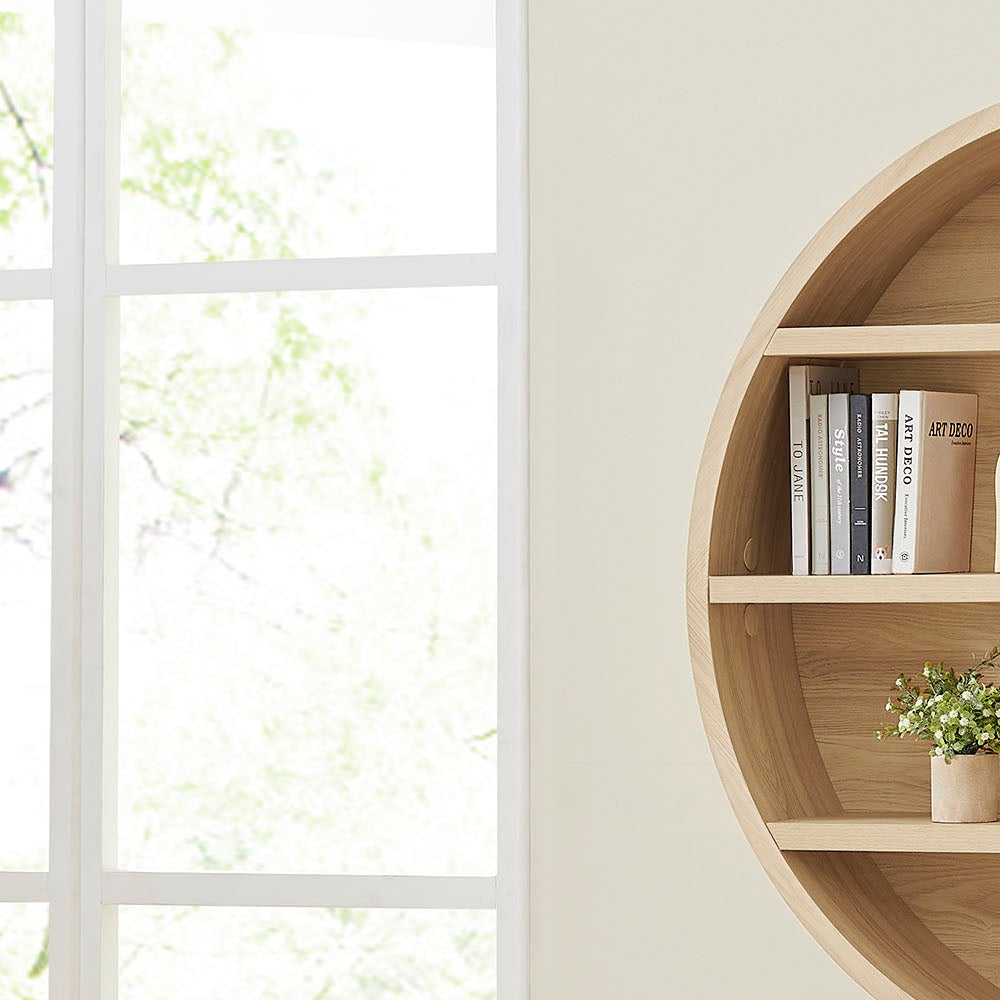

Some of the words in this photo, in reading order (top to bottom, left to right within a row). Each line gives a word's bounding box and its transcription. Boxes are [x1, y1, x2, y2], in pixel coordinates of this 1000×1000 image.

[875, 422, 888, 444] TAL
[904, 414, 913, 442] ART
[928, 421, 948, 437] ART
[949, 422, 974, 438] DECO
[793, 440, 803, 458] TO
[832, 428, 847, 472] Style
[903, 447, 912, 485] DECO
[793, 465, 804, 501] JANE
